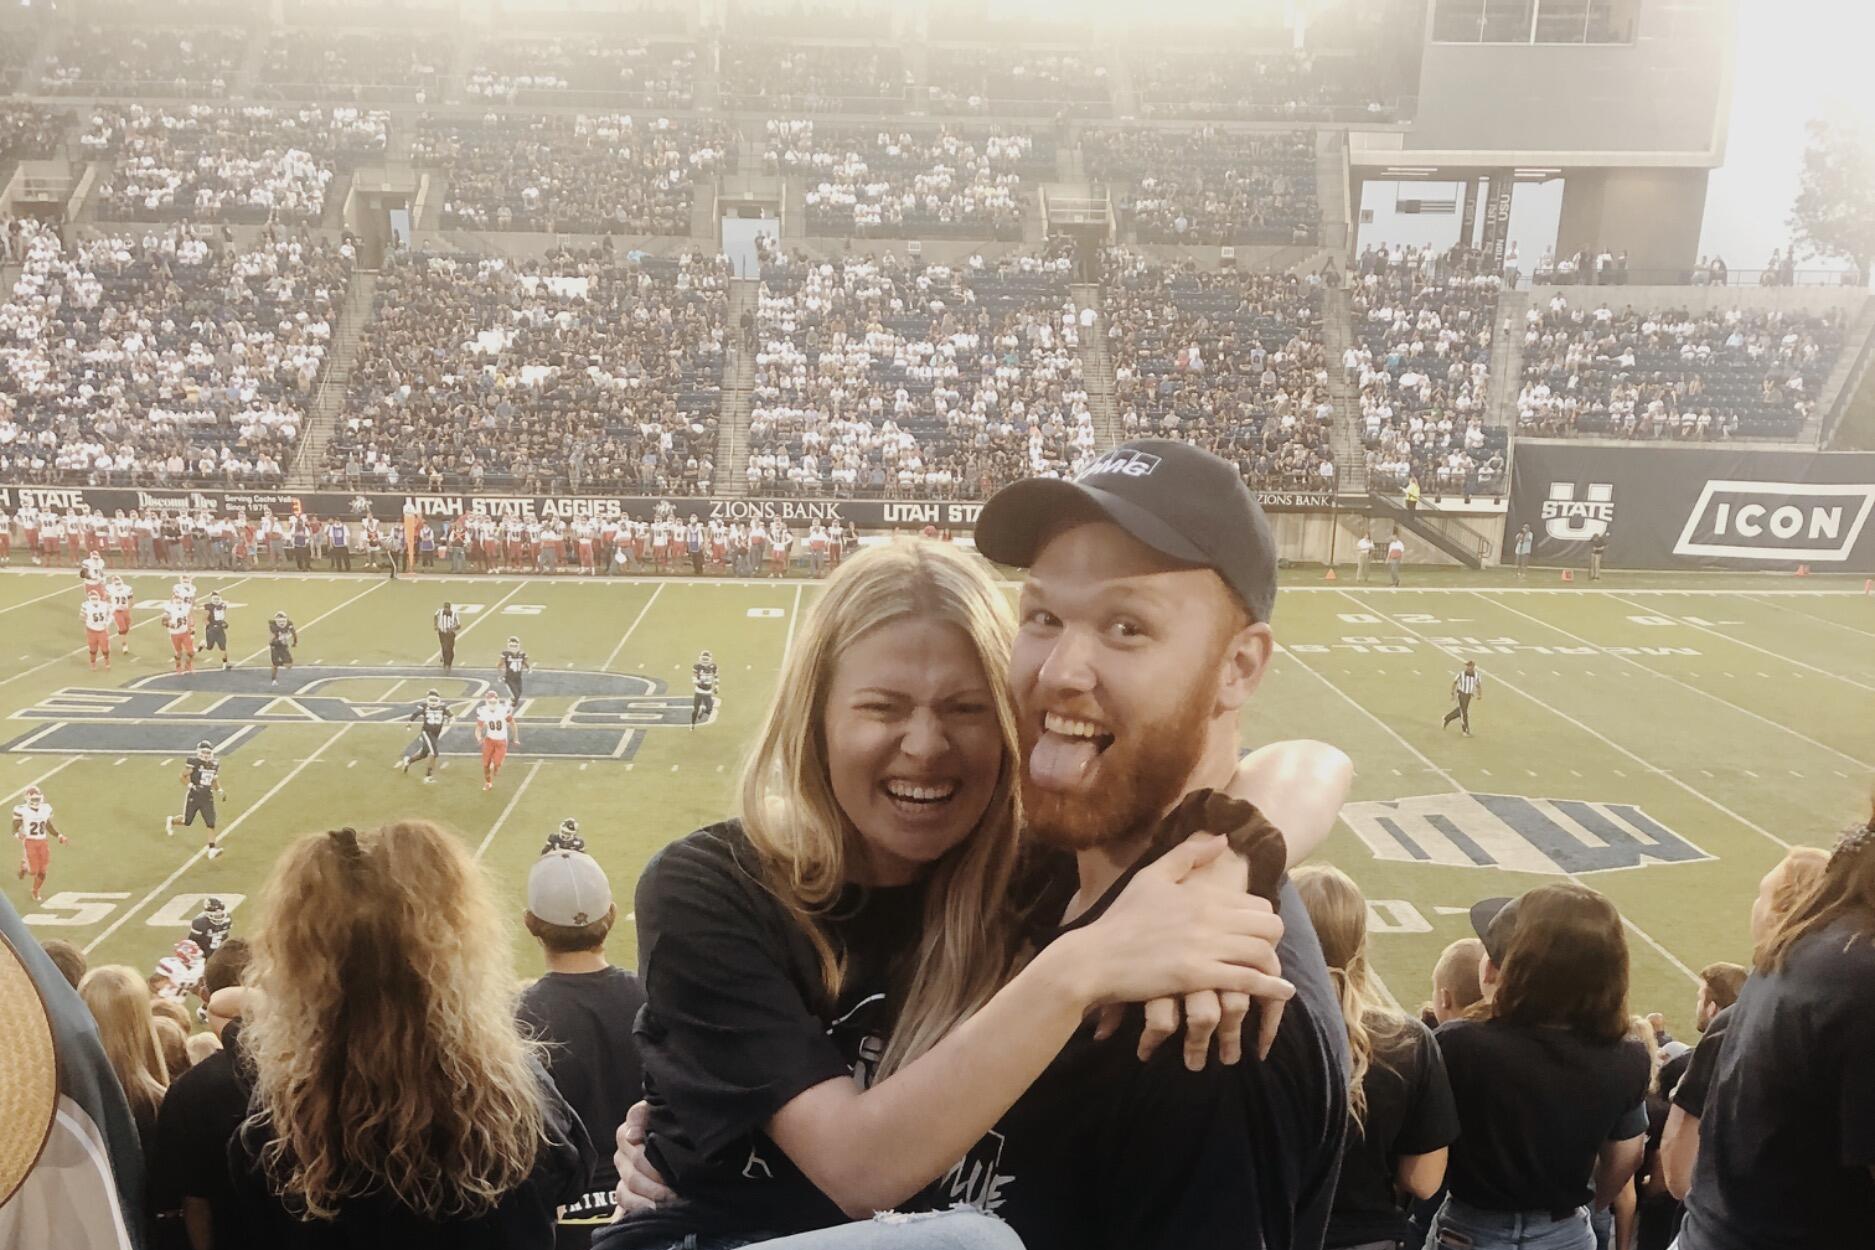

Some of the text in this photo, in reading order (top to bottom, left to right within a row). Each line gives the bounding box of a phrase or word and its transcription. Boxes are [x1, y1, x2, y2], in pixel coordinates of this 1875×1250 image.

[1498, 194, 1510, 221] USU
[18, 489, 83, 508] STATE
[405, 497, 621, 517] UTAH STATE AGGIES
[1256, 494, 1330, 506] ZIONS BANK
[709, 501, 841, 519] ZIONS BANK
[883, 503, 940, 522] UTAH
[1541, 501, 1614, 522] STATE
[1714, 503, 1843, 539] ICON
